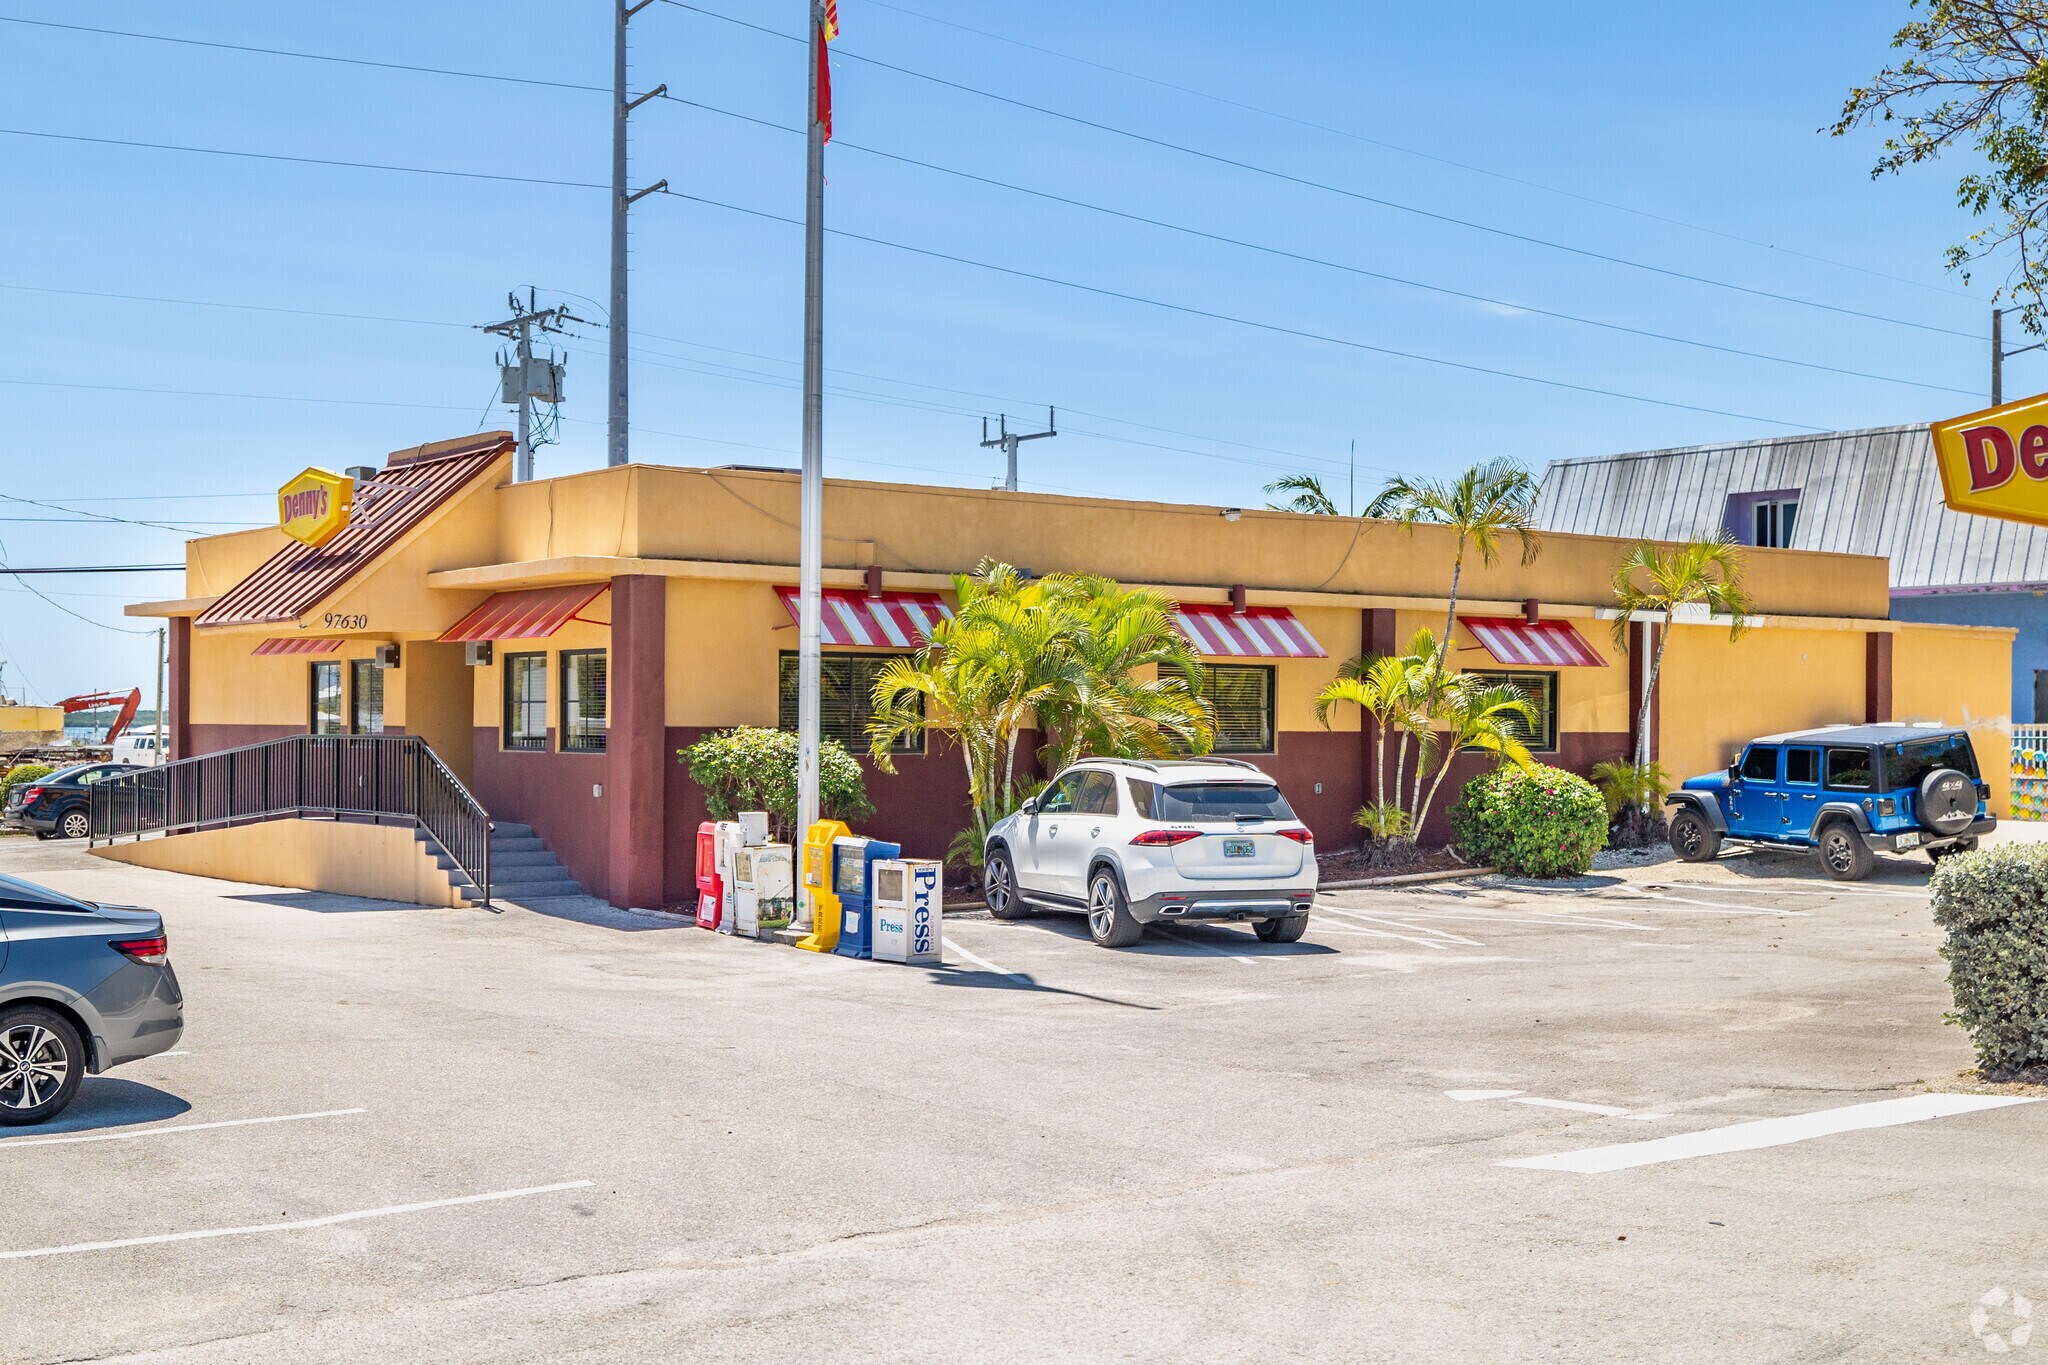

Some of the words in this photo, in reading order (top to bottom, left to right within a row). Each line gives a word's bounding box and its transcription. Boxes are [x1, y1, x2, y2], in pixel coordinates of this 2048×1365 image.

[1958, 424, 2048, 494] De
[283, 483, 328, 524] Denny's
[324, 612, 368, 629] 97630
[880, 918, 904, 933] Press
[914, 867, 936, 953] Press
